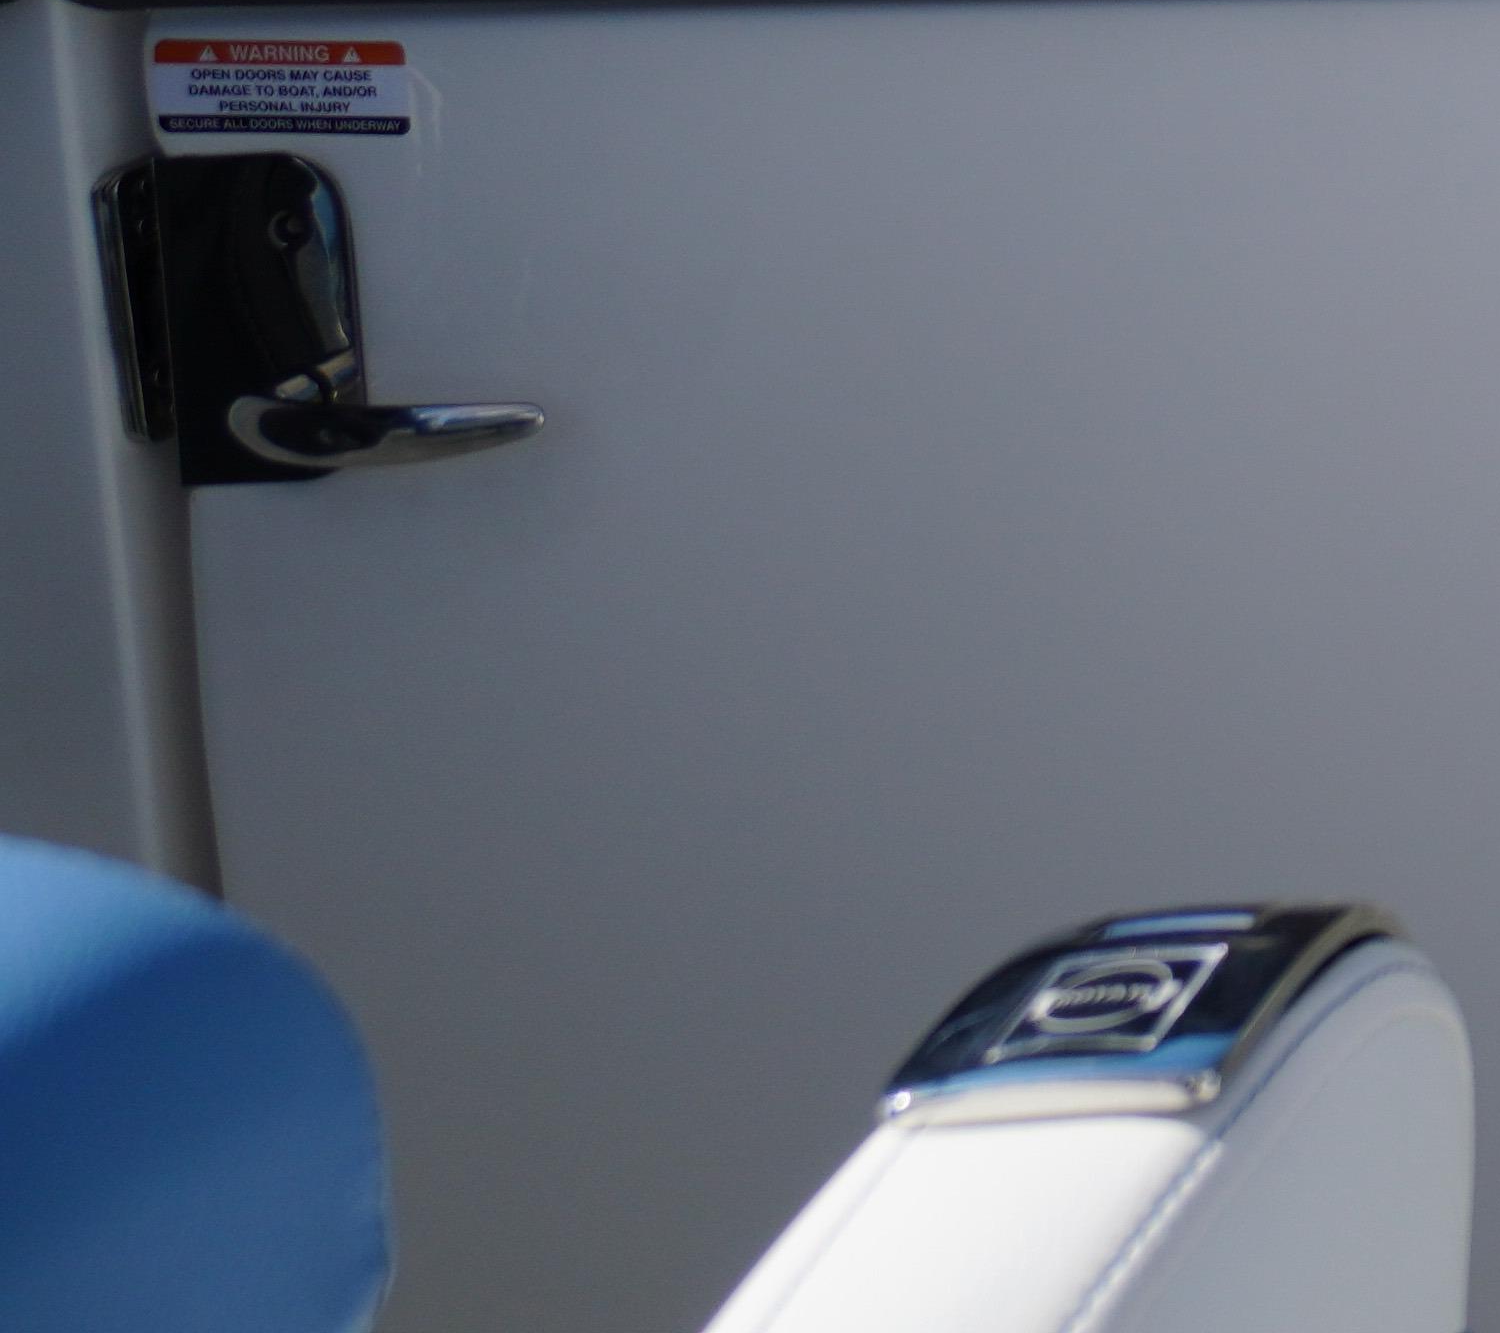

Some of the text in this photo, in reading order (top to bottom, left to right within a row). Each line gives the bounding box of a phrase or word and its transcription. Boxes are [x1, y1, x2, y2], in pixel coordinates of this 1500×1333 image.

[230, 44, 329, 63] WARNING
[191, 69, 371, 81] OPEN DOORS MAY CAUSE
[188, 85, 377, 98] DAMAGE TO BOAT, AND/OR
[219, 101, 350, 113] PERSONAL INJURY
[169, 119, 400, 131] SECURE ALL DOORS WHEN UNDERWAY
